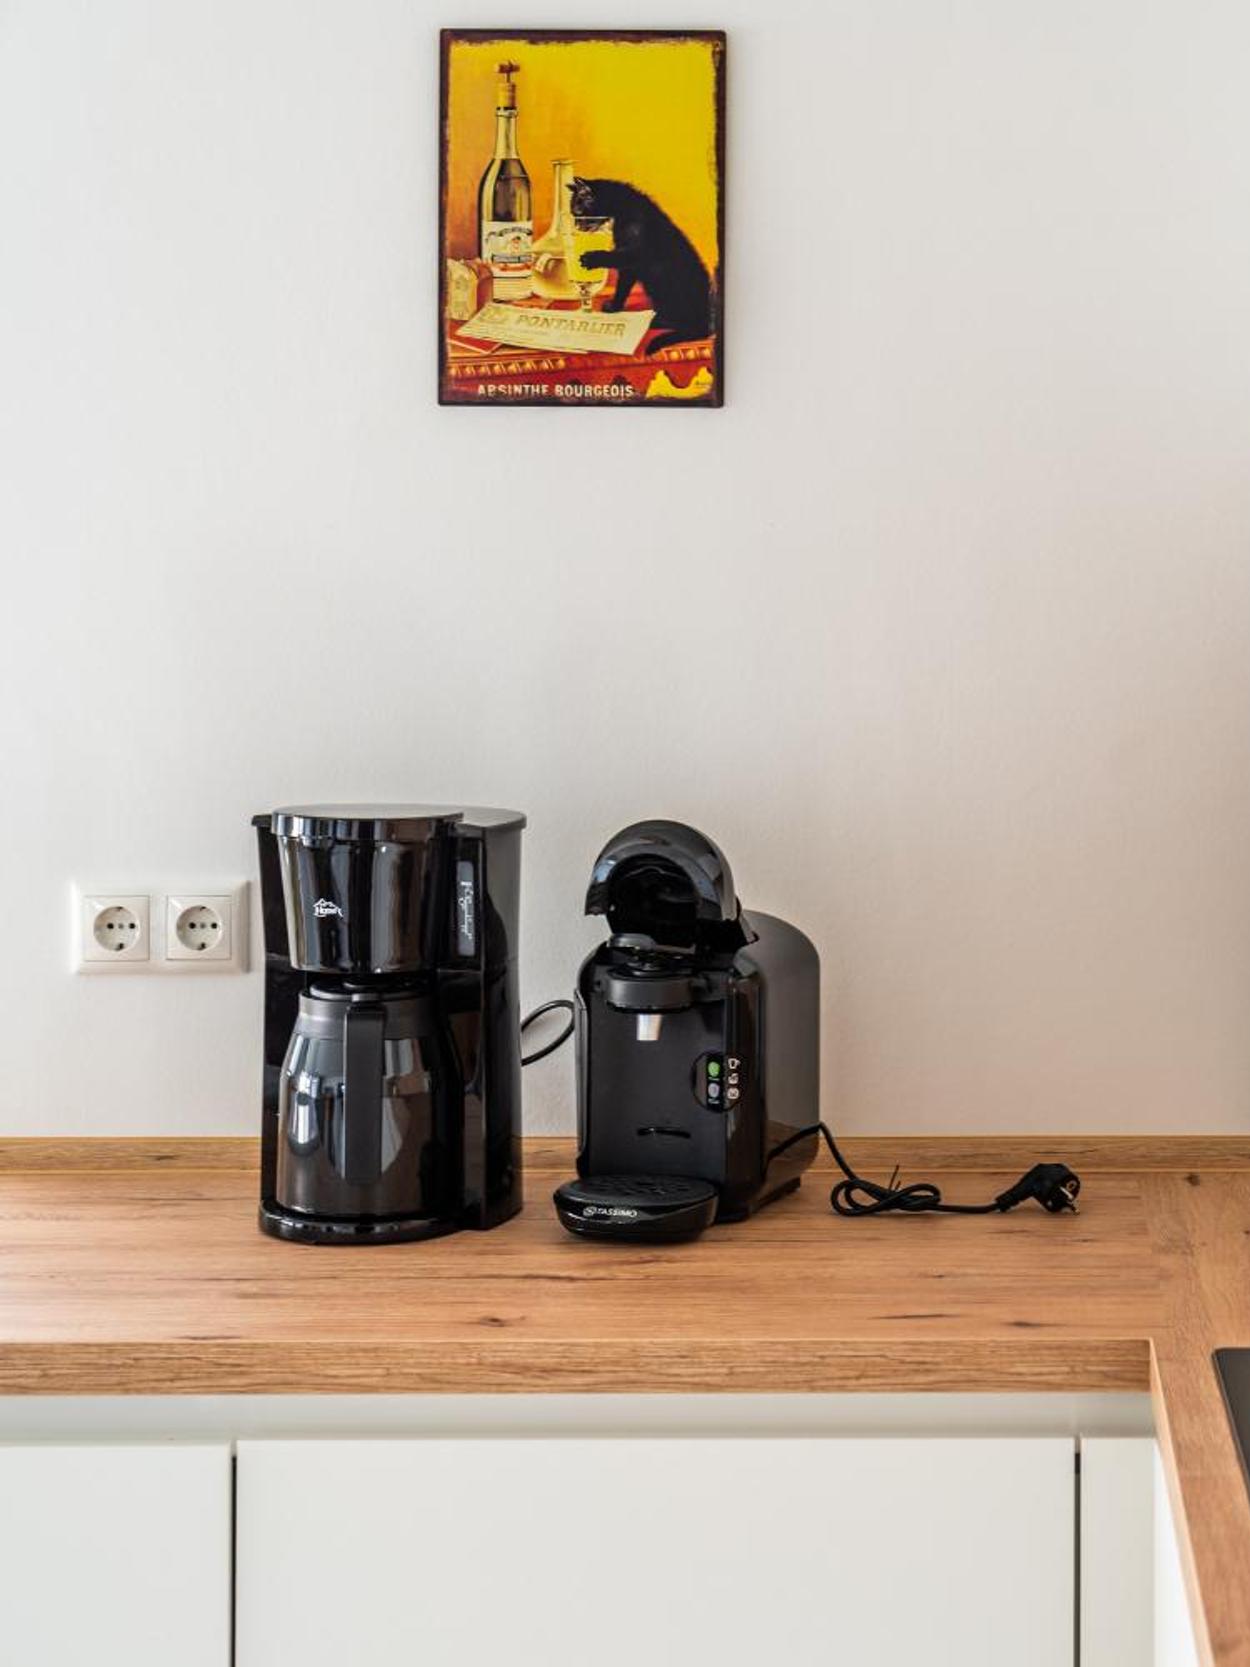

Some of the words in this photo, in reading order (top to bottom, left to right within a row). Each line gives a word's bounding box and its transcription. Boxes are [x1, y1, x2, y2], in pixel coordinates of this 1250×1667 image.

[516, 315, 626, 336] PONTARLIER
[477, 384, 548, 396] ABSINTHE
[554, 384, 635, 397] BOURGEOIS
[597, 1207, 638, 1218] TASSIMO
